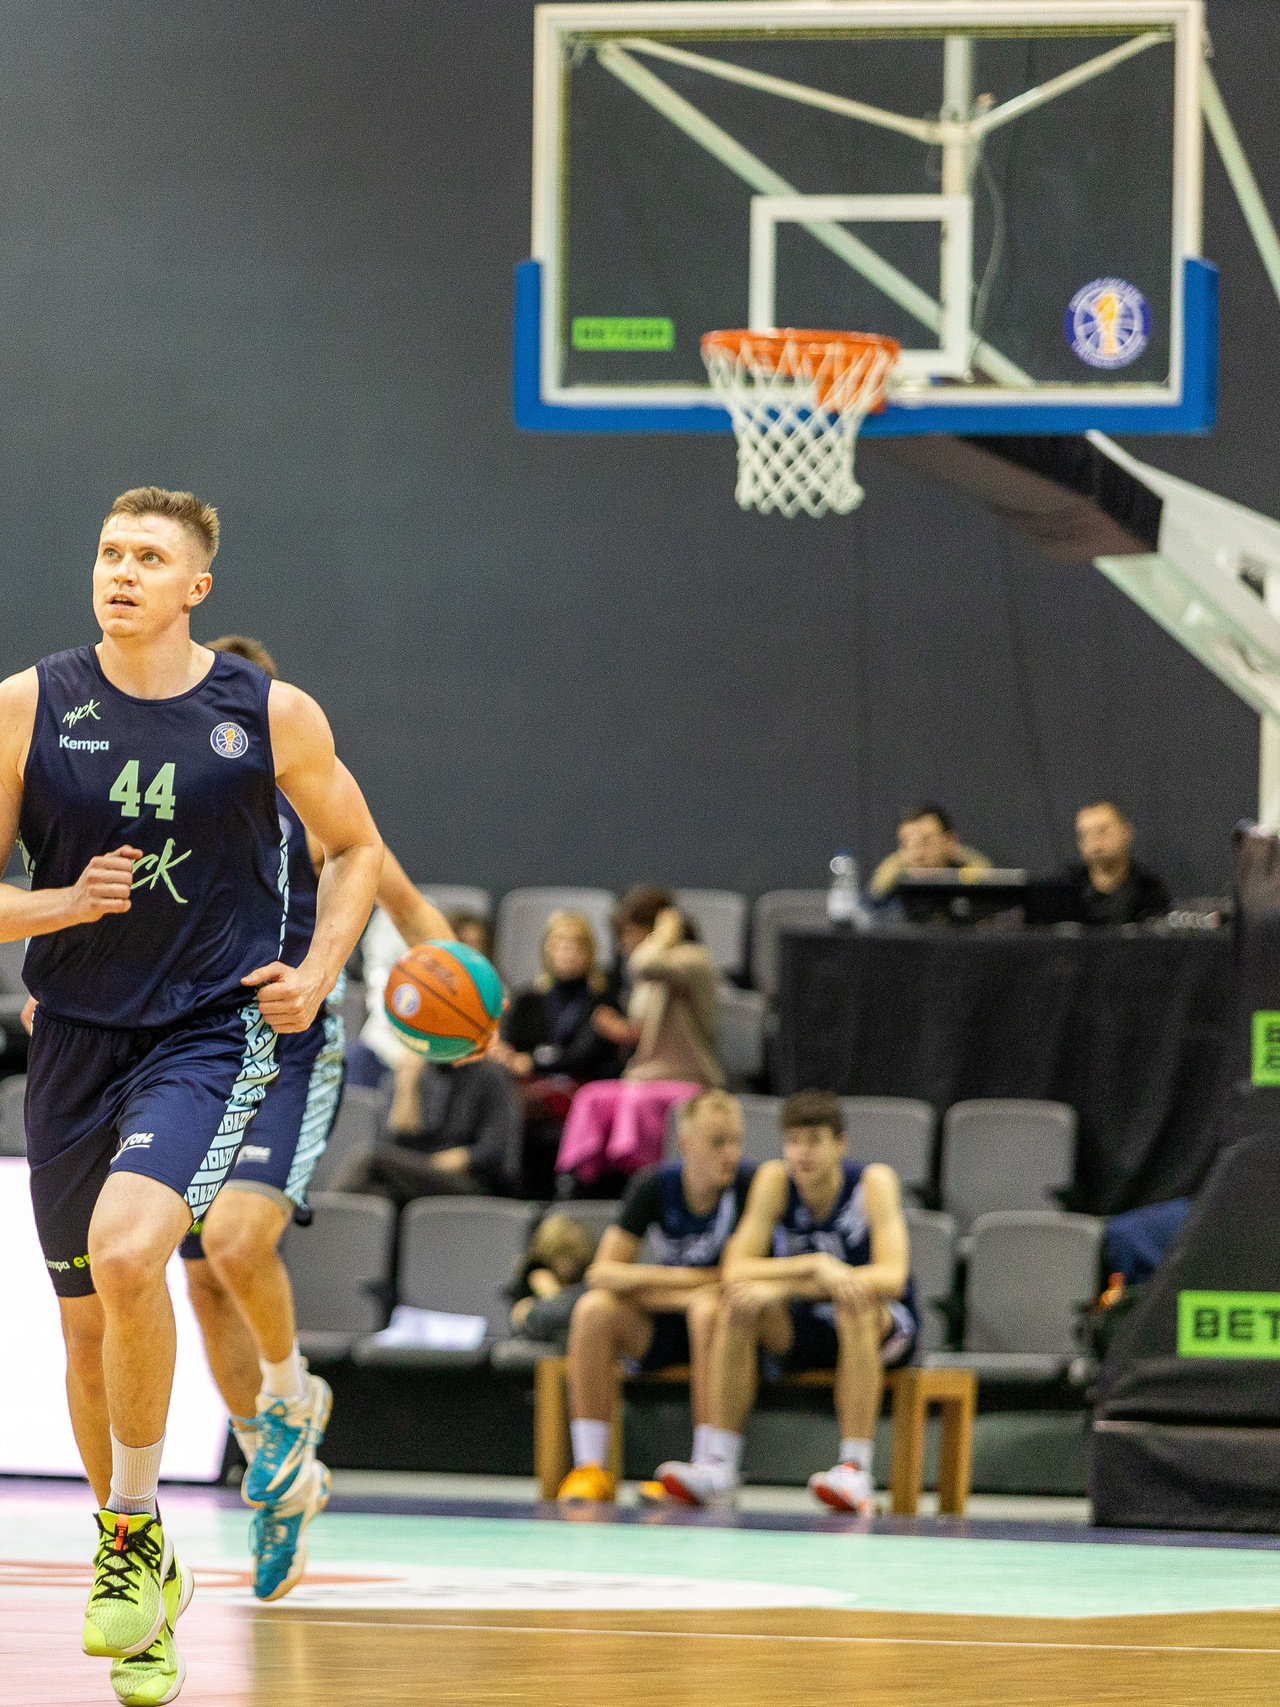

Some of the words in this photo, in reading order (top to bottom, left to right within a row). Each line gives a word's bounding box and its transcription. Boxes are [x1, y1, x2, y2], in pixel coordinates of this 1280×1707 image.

[59, 734, 110, 753] Kempa
[109, 760, 176, 821] 44
[1194, 1309, 1280, 1340] BET
